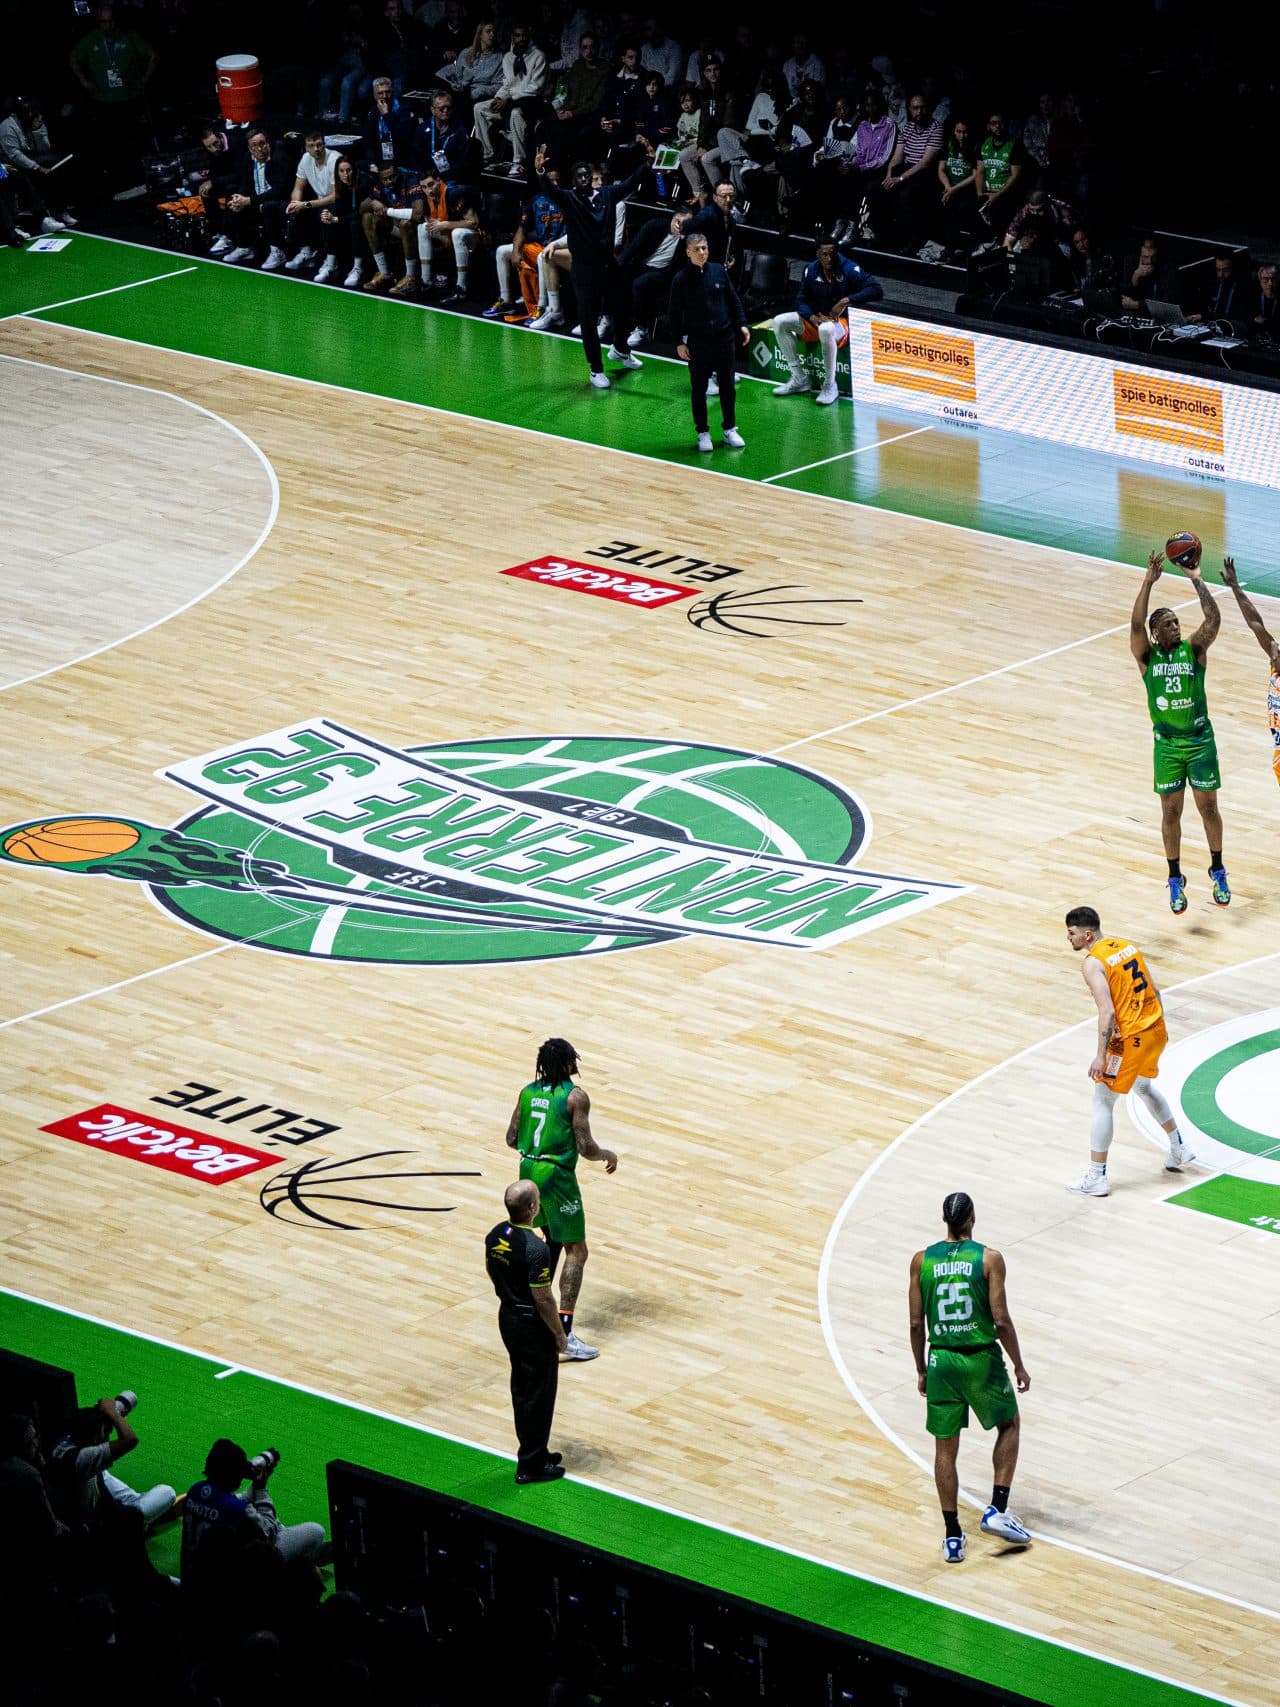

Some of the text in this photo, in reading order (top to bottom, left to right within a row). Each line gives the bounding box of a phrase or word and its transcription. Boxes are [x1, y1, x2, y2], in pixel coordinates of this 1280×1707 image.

[878, 337, 970, 367] spie batignolles
[943, 405, 978, 420] outarex
[1121, 387, 1217, 418] spie batignolles
[1188, 456, 1225, 473] outarex
[583, 540, 744, 583] ÉLITE
[530, 562, 683, 602] Betclic
[1165, 676, 1182, 693] 23
[563, 802, 638, 825] 1927
[201, 730, 929, 939] NANTERRE 92
[384, 871, 447, 889] JSF
[1123, 958, 1148, 994] 3
[1133, 1037, 1140, 1048] 3
[149, 1081, 342, 1146] ÉLITE
[78, 1114, 260, 1175] Betclic
[531, 1111, 546, 1148] 7
[936, 1282, 974, 1321] 25
[949, 1322, 979, 1334] PAPREC
